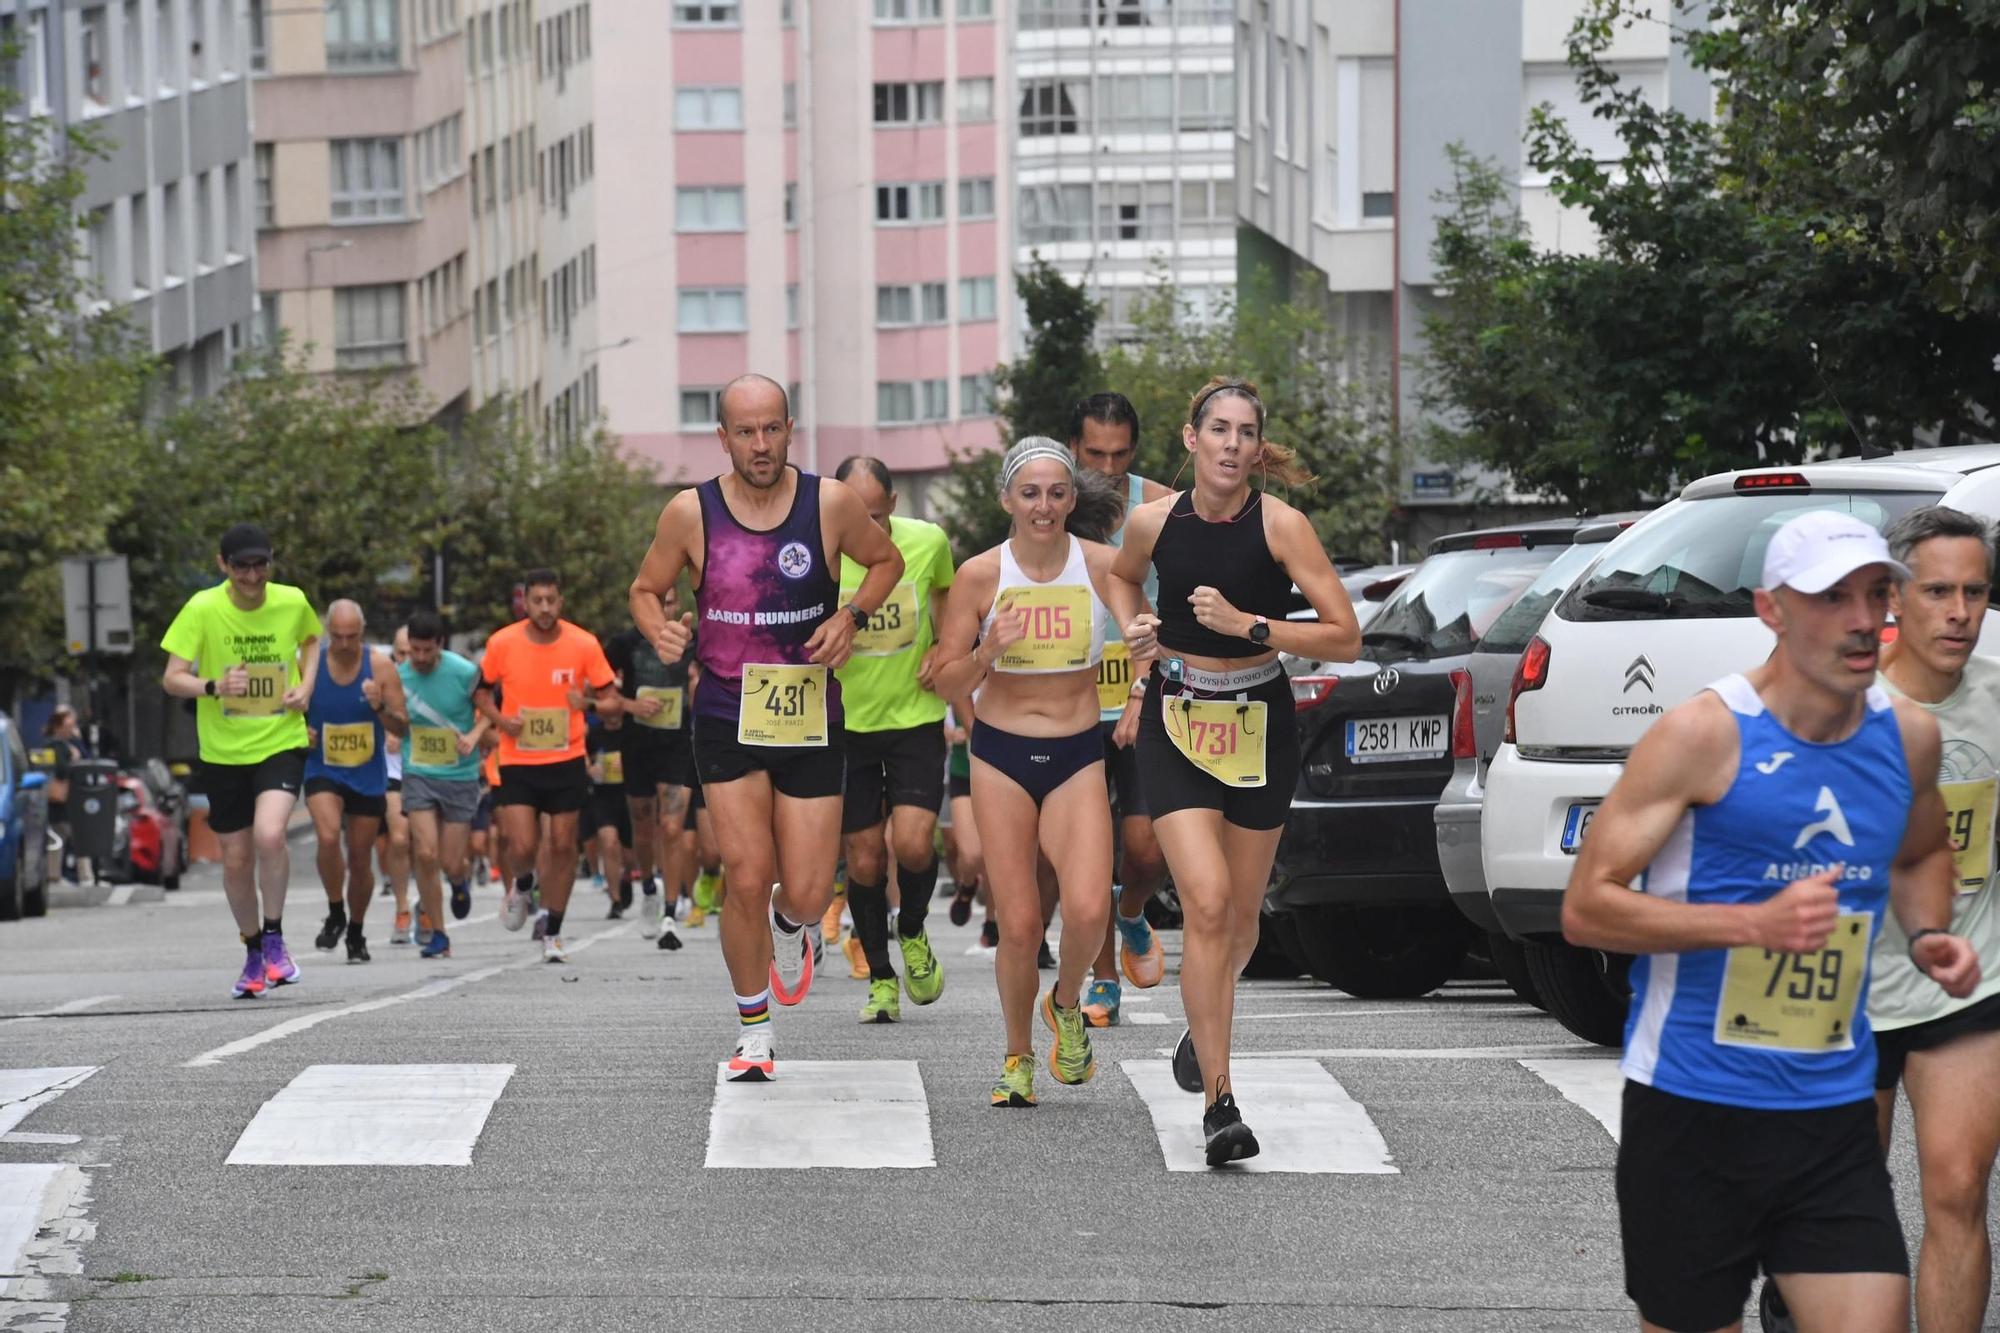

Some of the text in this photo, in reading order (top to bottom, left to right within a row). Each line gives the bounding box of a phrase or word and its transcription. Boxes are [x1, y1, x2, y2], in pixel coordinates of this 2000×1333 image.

[706, 602, 825, 625] SARDI RUNNERS
[864, 603, 901, 632] 53
[1016, 607, 1071, 640] 705
[234, 634, 276, 645] RUNNING
[1200, 676, 1230, 687] OYSHO
[1233, 672, 1261, 684] OYSHO
[765, 685, 805, 716] 431
[530, 718, 554, 737] 134
[1191, 720, 1237, 755] 731
[1358, 719, 1442, 751] 2581 KWP
[329, 733, 367, 752] 3294
[1763, 948, 1843, 1002] 759
